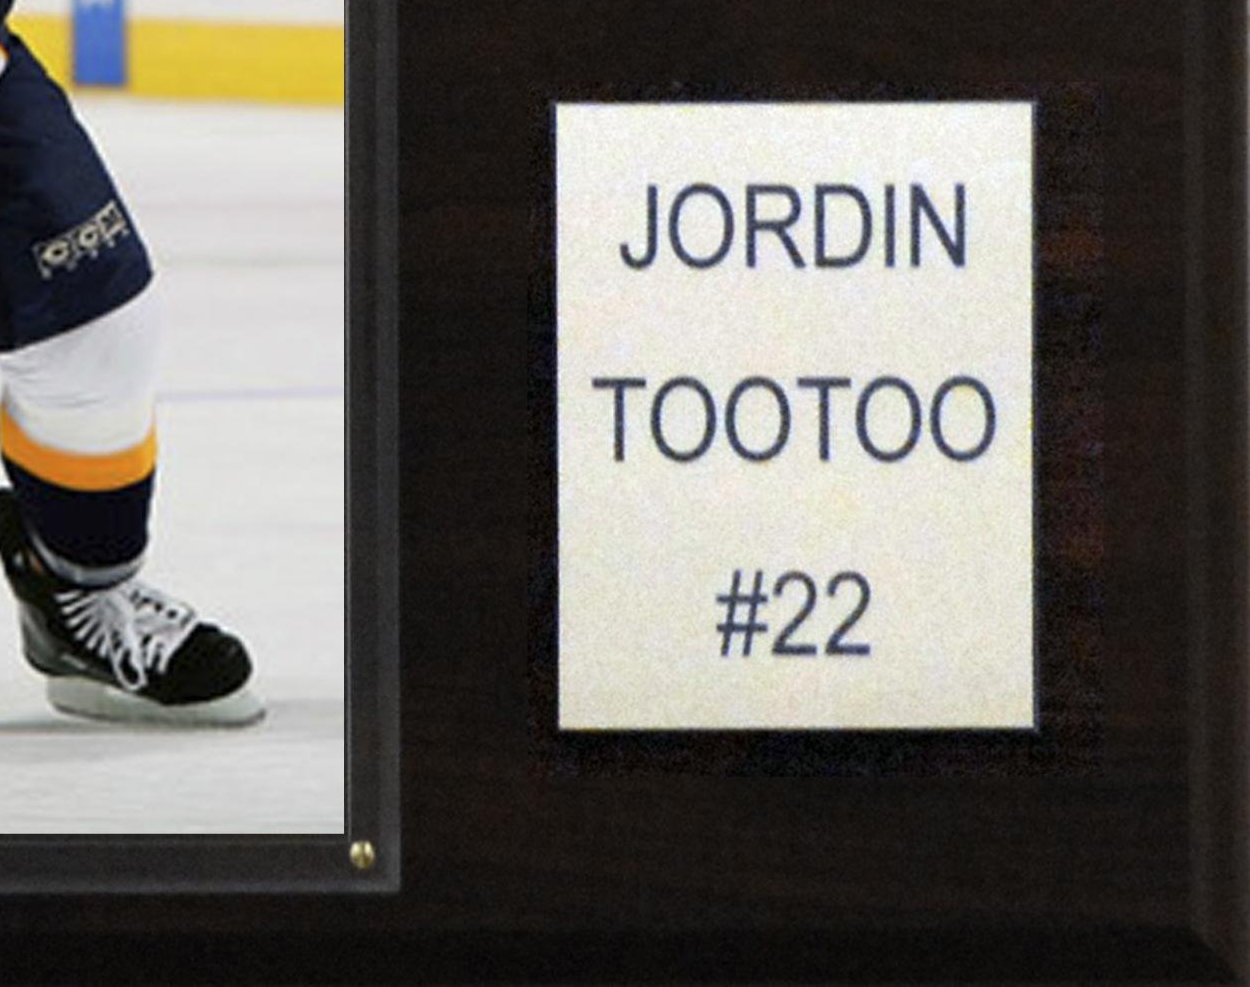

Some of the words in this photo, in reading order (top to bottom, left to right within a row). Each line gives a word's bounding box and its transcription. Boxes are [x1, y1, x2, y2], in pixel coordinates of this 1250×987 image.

[620, 182, 967, 270] JORDIN
[591, 376, 997, 463] TOOTOO
[716, 570, 872, 657] #22
